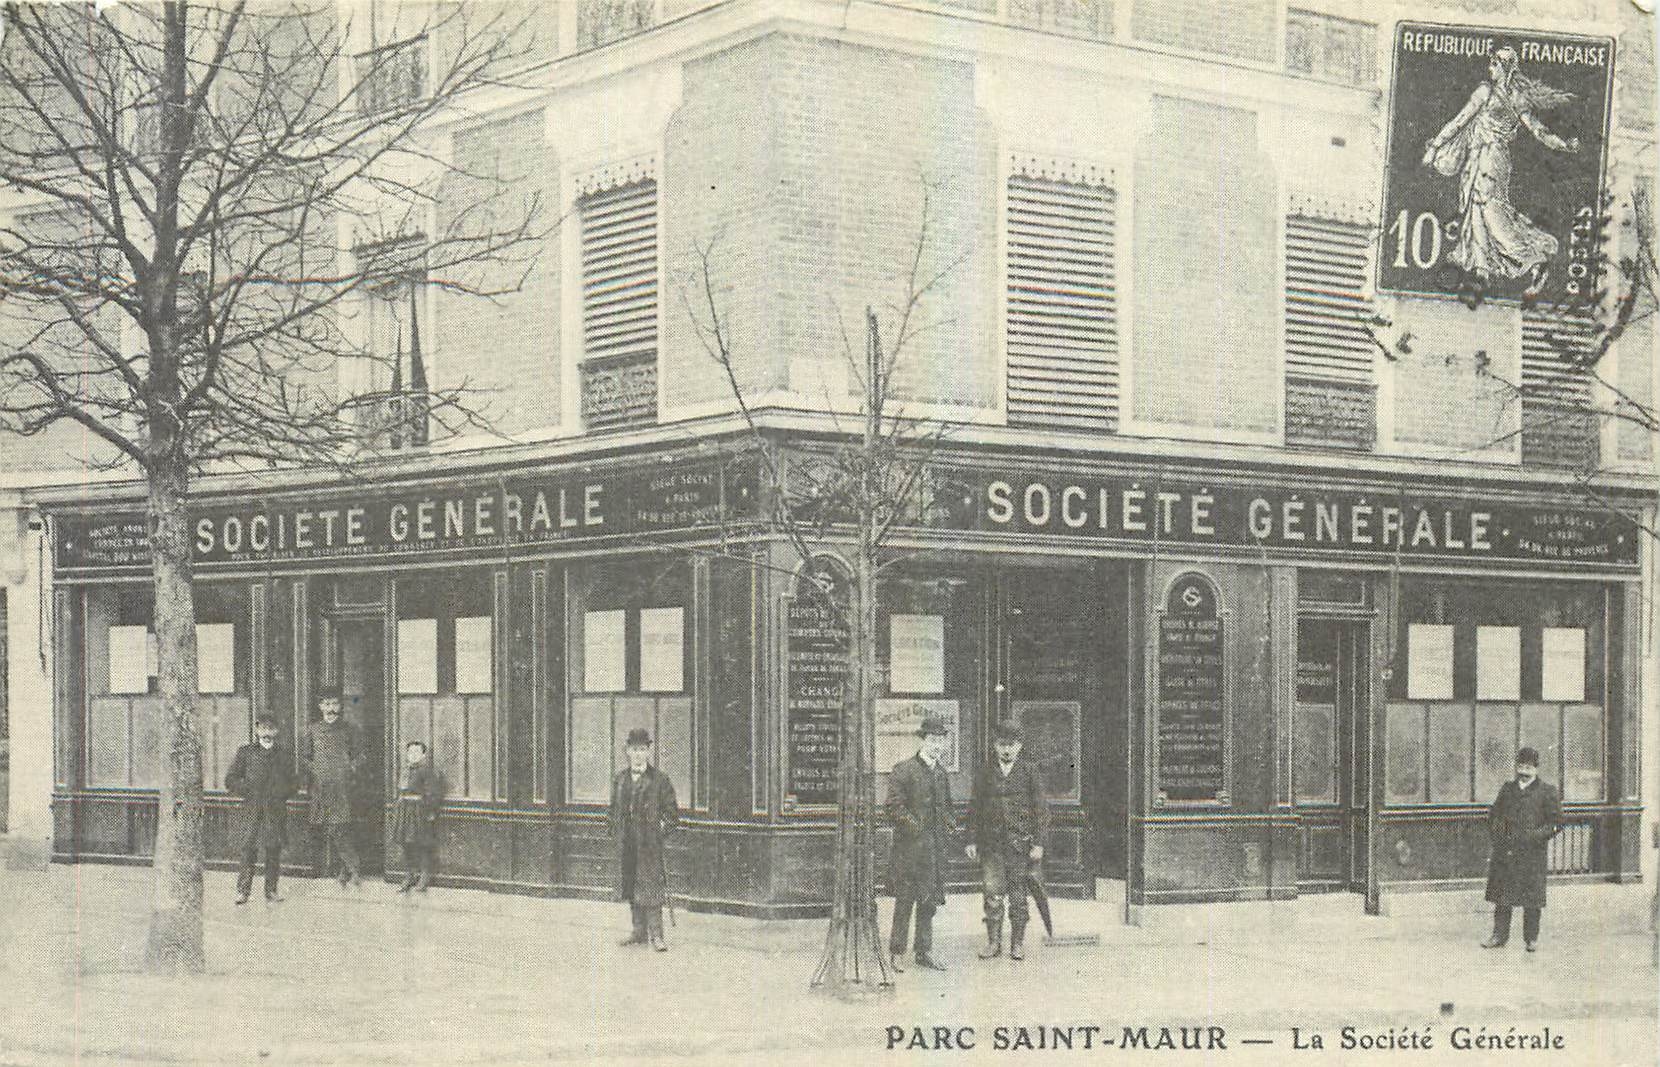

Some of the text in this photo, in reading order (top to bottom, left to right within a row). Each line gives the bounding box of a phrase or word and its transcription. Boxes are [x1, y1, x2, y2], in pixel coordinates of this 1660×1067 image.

[1521, 41, 1605, 67] FRANÇAISE
[196, 485, 604, 554] SOCIÉTÉ GÉNÉRALE
[987, 481, 1215, 535] SOCIÉTÉ
[1248, 495, 1492, 550] GÉNÉRALE
